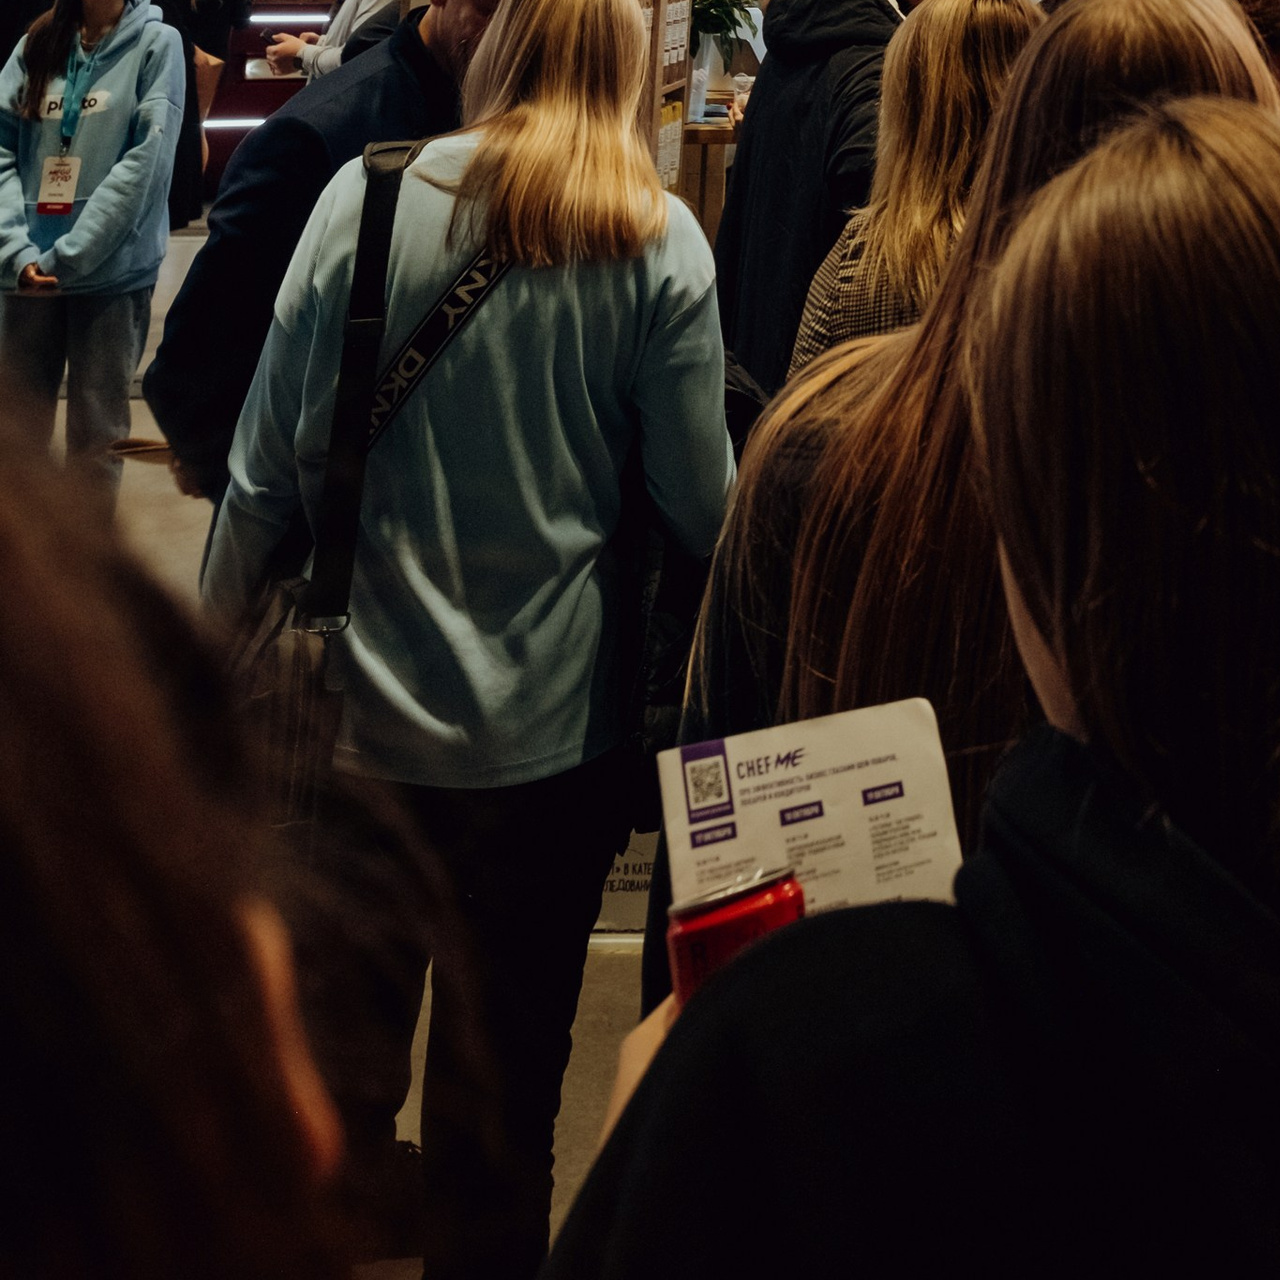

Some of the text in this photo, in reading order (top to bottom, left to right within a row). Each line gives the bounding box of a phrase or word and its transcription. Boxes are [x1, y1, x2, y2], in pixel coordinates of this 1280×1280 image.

[47, 97, 97, 115] plto
[441, 258, 498, 330] KNY
[368, 346, 427, 436] DKN
[736, 747, 806, 780] CHEF ME
[632, 862, 653, 875] КАТЕ
